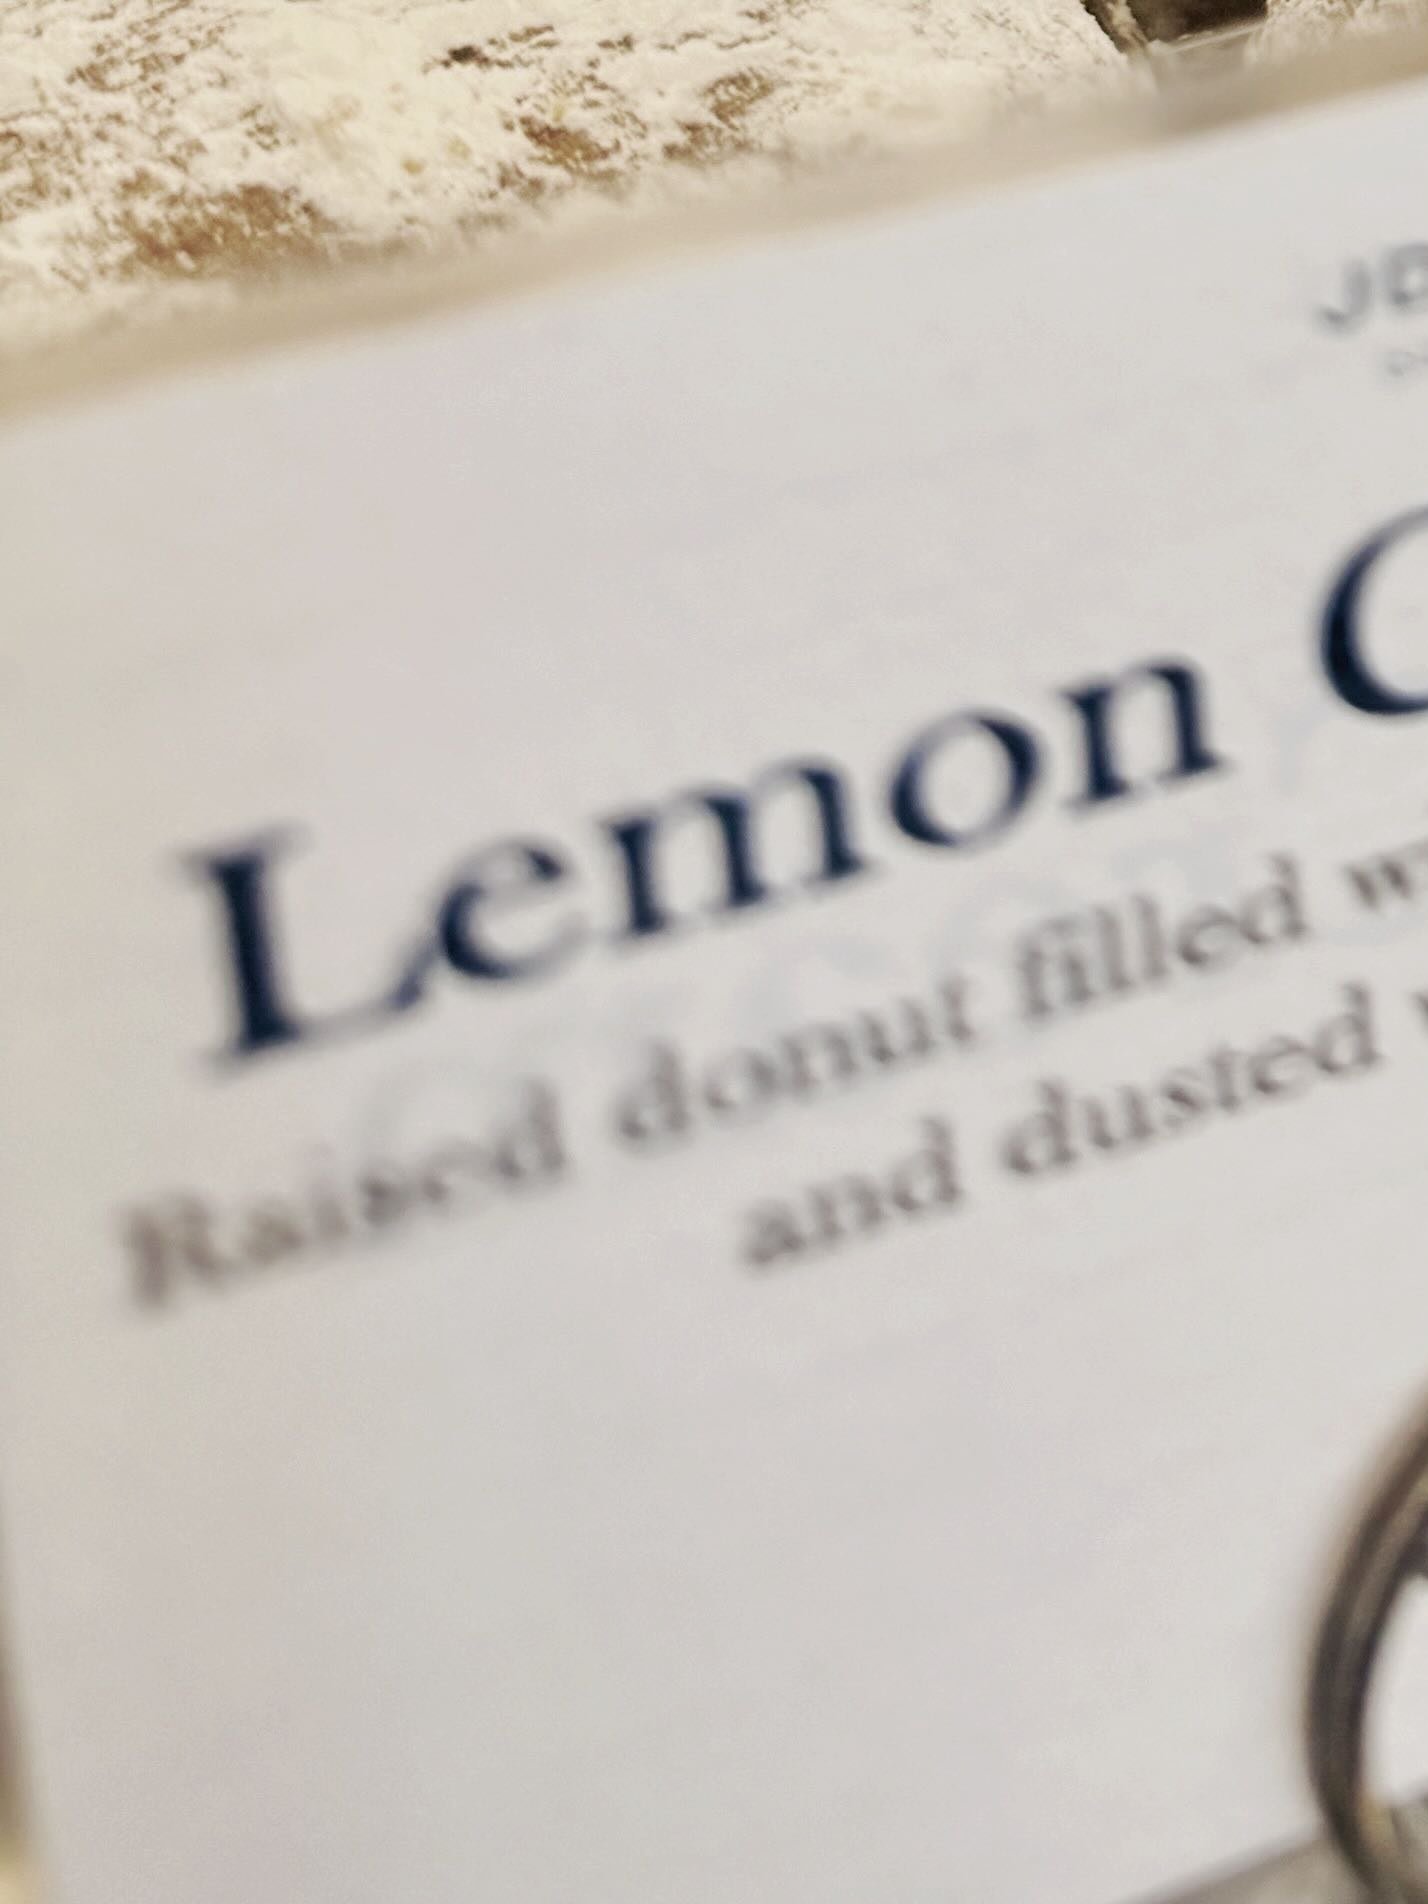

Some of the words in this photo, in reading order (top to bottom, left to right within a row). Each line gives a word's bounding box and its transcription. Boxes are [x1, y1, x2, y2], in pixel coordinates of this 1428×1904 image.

[180, 652, 1234, 1077] Lemon
[119, 1075, 569, 1313] Raised
[611, 971, 981, 1149] donut
[1014, 846, 1308, 1028] filled
[740, 1107, 970, 1276] and
[995, 979, 1387, 1182] dusted
